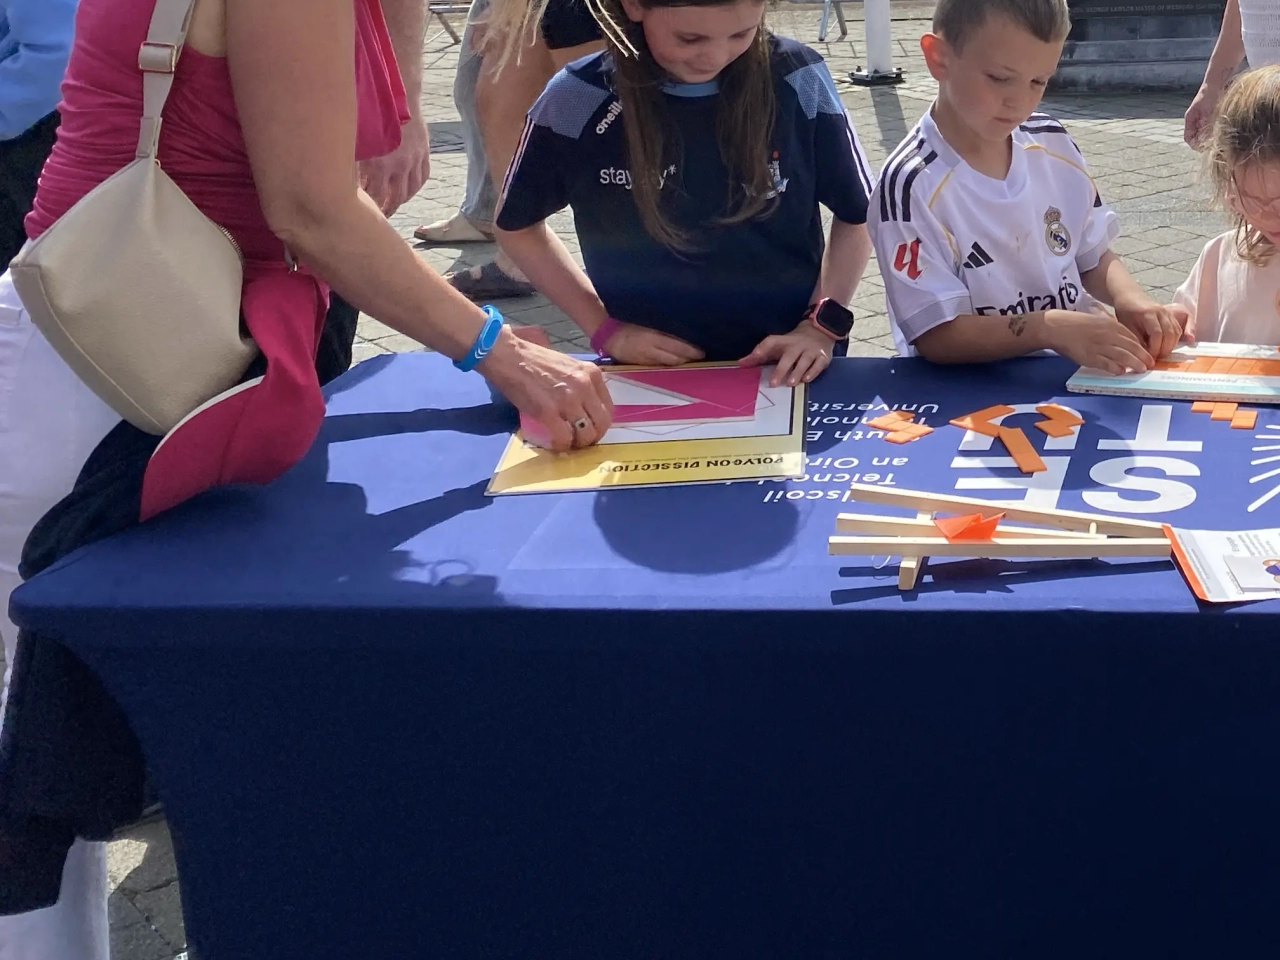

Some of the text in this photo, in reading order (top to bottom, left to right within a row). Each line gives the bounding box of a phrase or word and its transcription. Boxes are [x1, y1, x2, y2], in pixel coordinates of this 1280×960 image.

[808, 401, 940, 413] Universit
[600, 460, 700, 473] DISSECTION
[706, 457, 783, 468] POLYGON
[806, 457, 909, 468] an Oir
